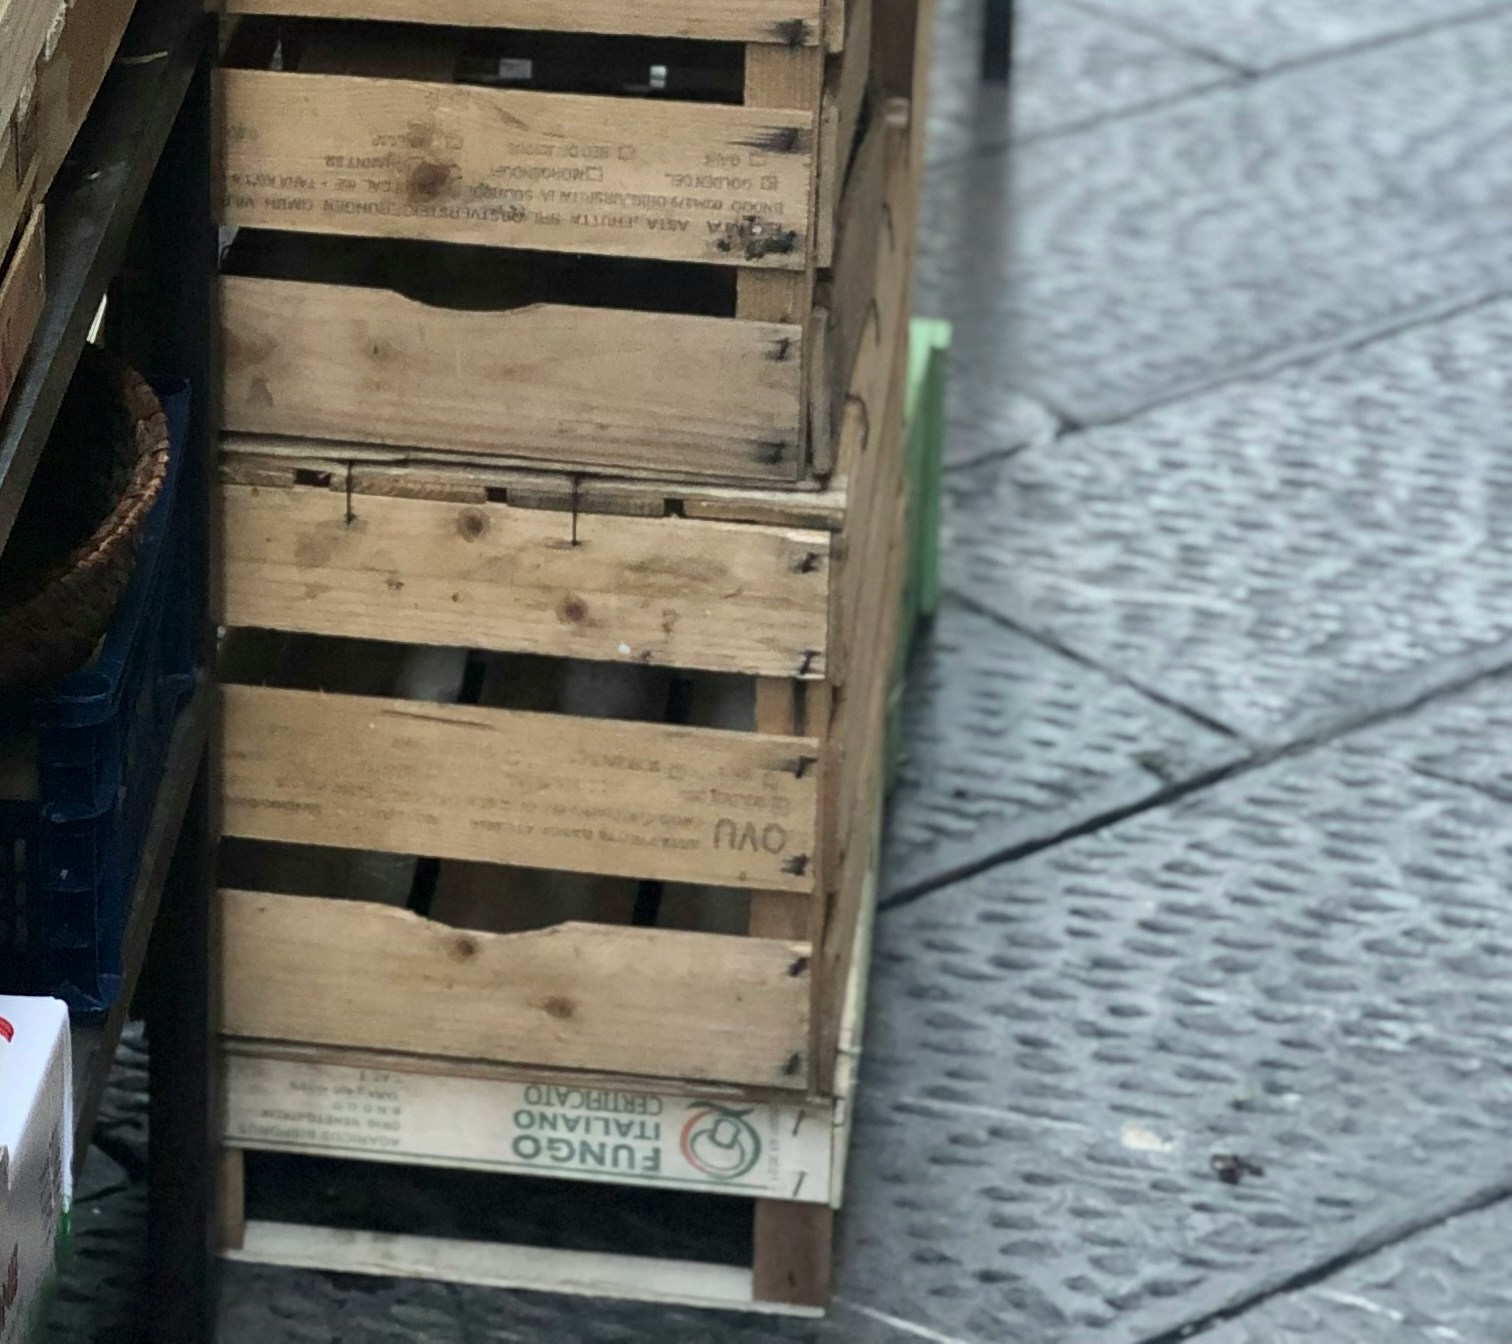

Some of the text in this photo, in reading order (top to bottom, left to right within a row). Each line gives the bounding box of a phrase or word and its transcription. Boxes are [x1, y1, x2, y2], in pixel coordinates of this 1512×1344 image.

[713, 818, 788, 855] OVU
[522, 1083, 664, 1116] CERTIFICATO
[513, 1108, 662, 1142] ITALIANO
[511, 1134, 662, 1173] FUNGO
